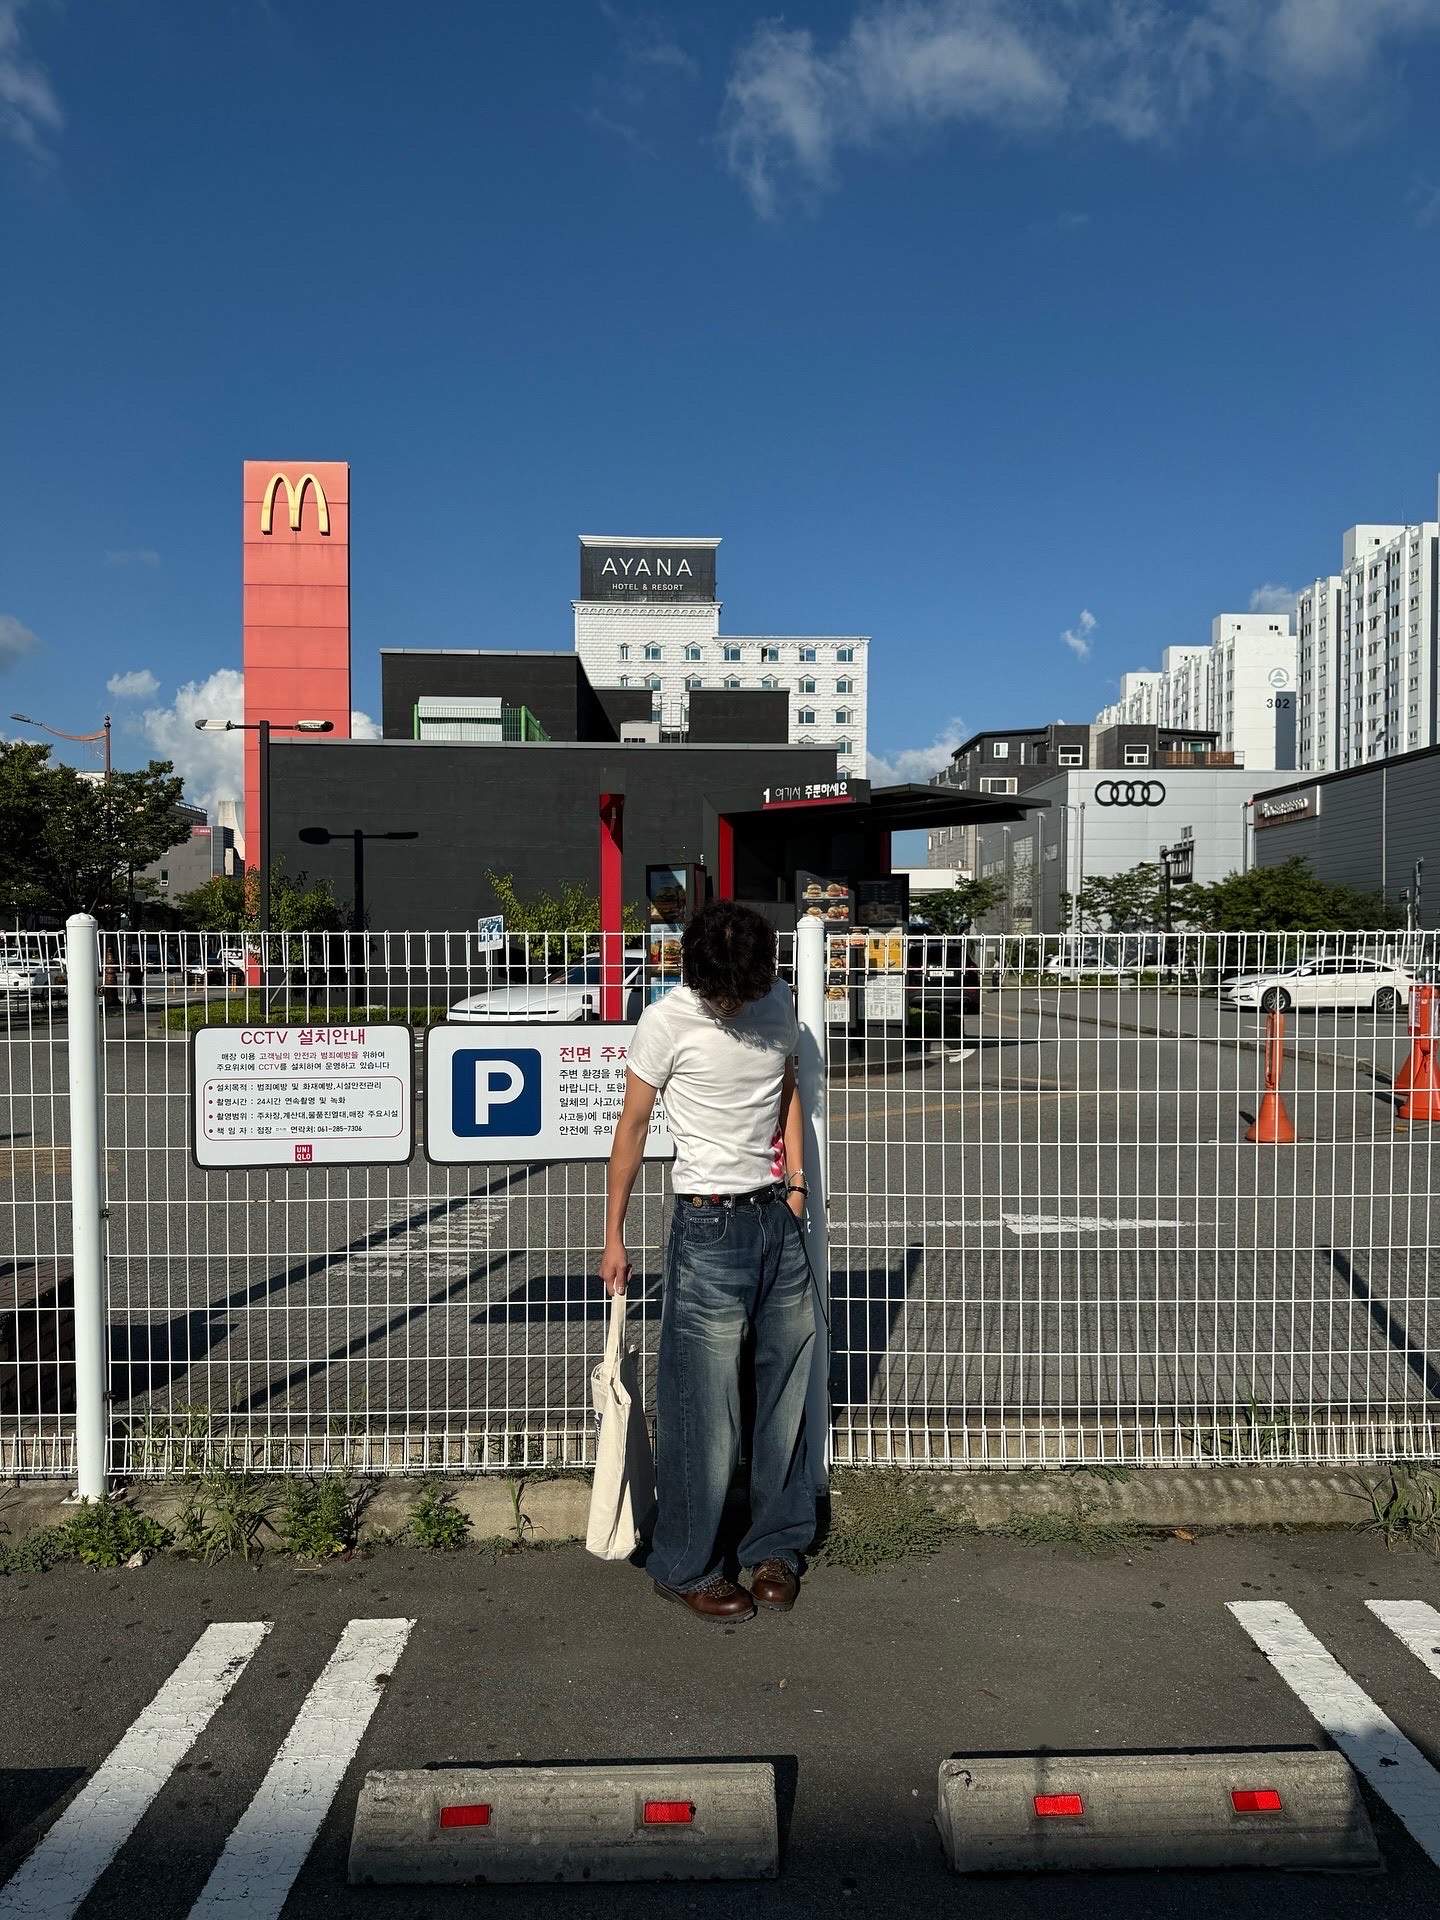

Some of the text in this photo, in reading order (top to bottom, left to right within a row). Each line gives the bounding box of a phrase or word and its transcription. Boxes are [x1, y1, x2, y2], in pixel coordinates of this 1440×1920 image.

[601, 557, 693, 577] AYANA
[612, 583, 639, 591] HOTEL
[652, 583, 684, 591] RESORT
[1266, 698, 1290, 709] 302
[763, 781, 848, 804] 1 여기서 주문하세요
[240, 1028, 365, 1046] CCTV 설치안내
[221, 1050, 386, 1061] 매장 이용 고객님의 안전과 범죄예방을 위하여
[559, 1046, 591, 1063] 전면
[216, 1061, 390, 1072] 주요위치에 CCTV를 설치하여 운영하고 있습니다
[559, 1069, 578, 1079] 주변
[582, 1068, 610, 1080] 환경을
[216, 1083, 248, 1092] 설치목적
[256, 1083, 288, 1091] 범죄예방
[291, 1082, 299, 1091] 및
[475, 1060, 525, 1125] P
[559, 1082, 626, 1094] 바랍니다. 또한
[256, 1097, 282, 1106] 24시간
[318, 1096, 327, 1105] 및
[330, 1096, 346, 1105] 녹화
[559, 1097, 588, 1108] 일체의
[367, 1109, 399, 1118] 주요시설
[558, 1111, 597, 1122] 사고등)에
[317, 1125, 363, 1133] 061-285-7306
[559, 1124, 613, 1136] 안전에 유의
[296, 1153, 311, 1161] QLO
